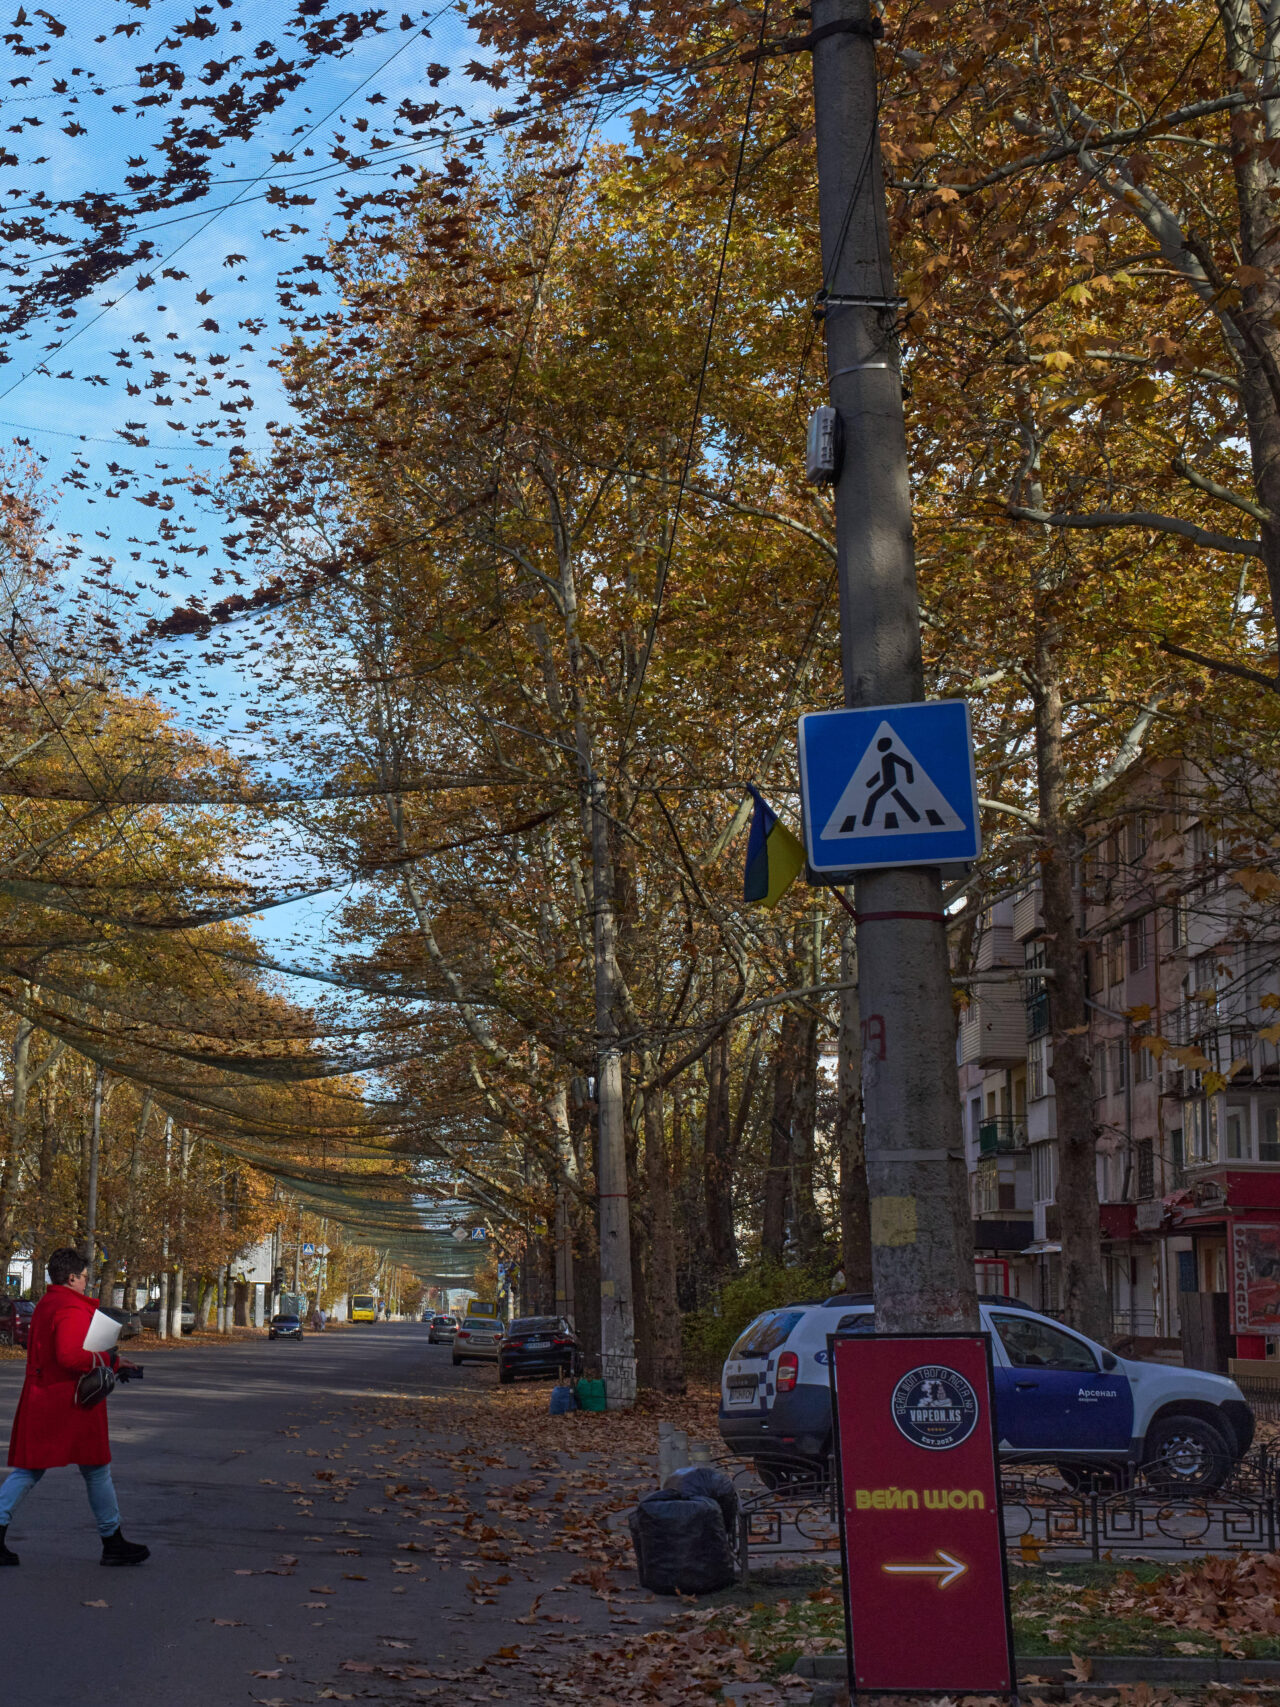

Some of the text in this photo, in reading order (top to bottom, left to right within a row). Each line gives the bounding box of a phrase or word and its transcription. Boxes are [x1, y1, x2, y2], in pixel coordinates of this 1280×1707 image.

[1078, 1388, 1117, 1398] Арсенал
[910, 1409, 961, 1422] VAPEON.KS
[856, 1486, 985, 1510] ВЕЙП ШОП
